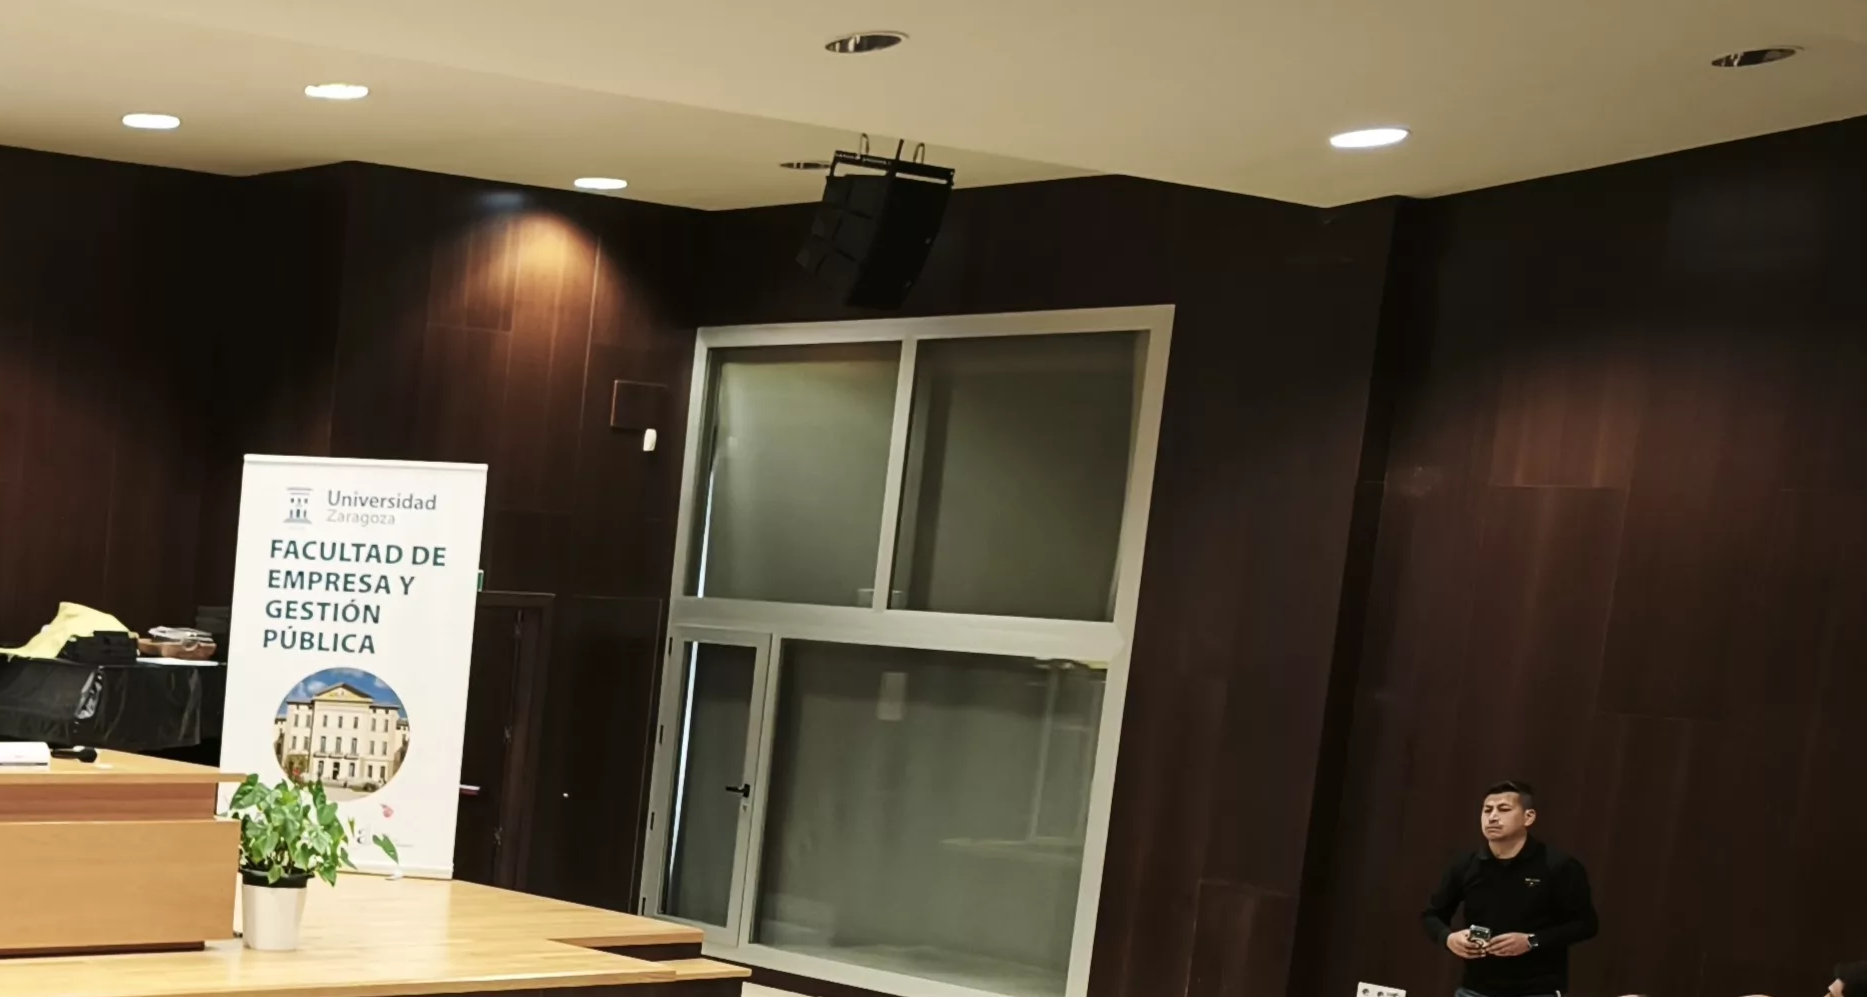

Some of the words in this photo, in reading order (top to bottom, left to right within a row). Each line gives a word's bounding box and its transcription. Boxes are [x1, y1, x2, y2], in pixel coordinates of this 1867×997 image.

[326, 490, 438, 511] Universidad
[326, 508, 396, 527] Zaragoza
[270, 539, 404, 564] FACULTAD
[411, 546, 447, 566] DE
[268, 569, 392, 595] EMPRESA
[400, 576, 416, 595] Y
[265, 599, 381, 624] GESTIÓN
[263, 626, 376, 654] PÚBLICA
